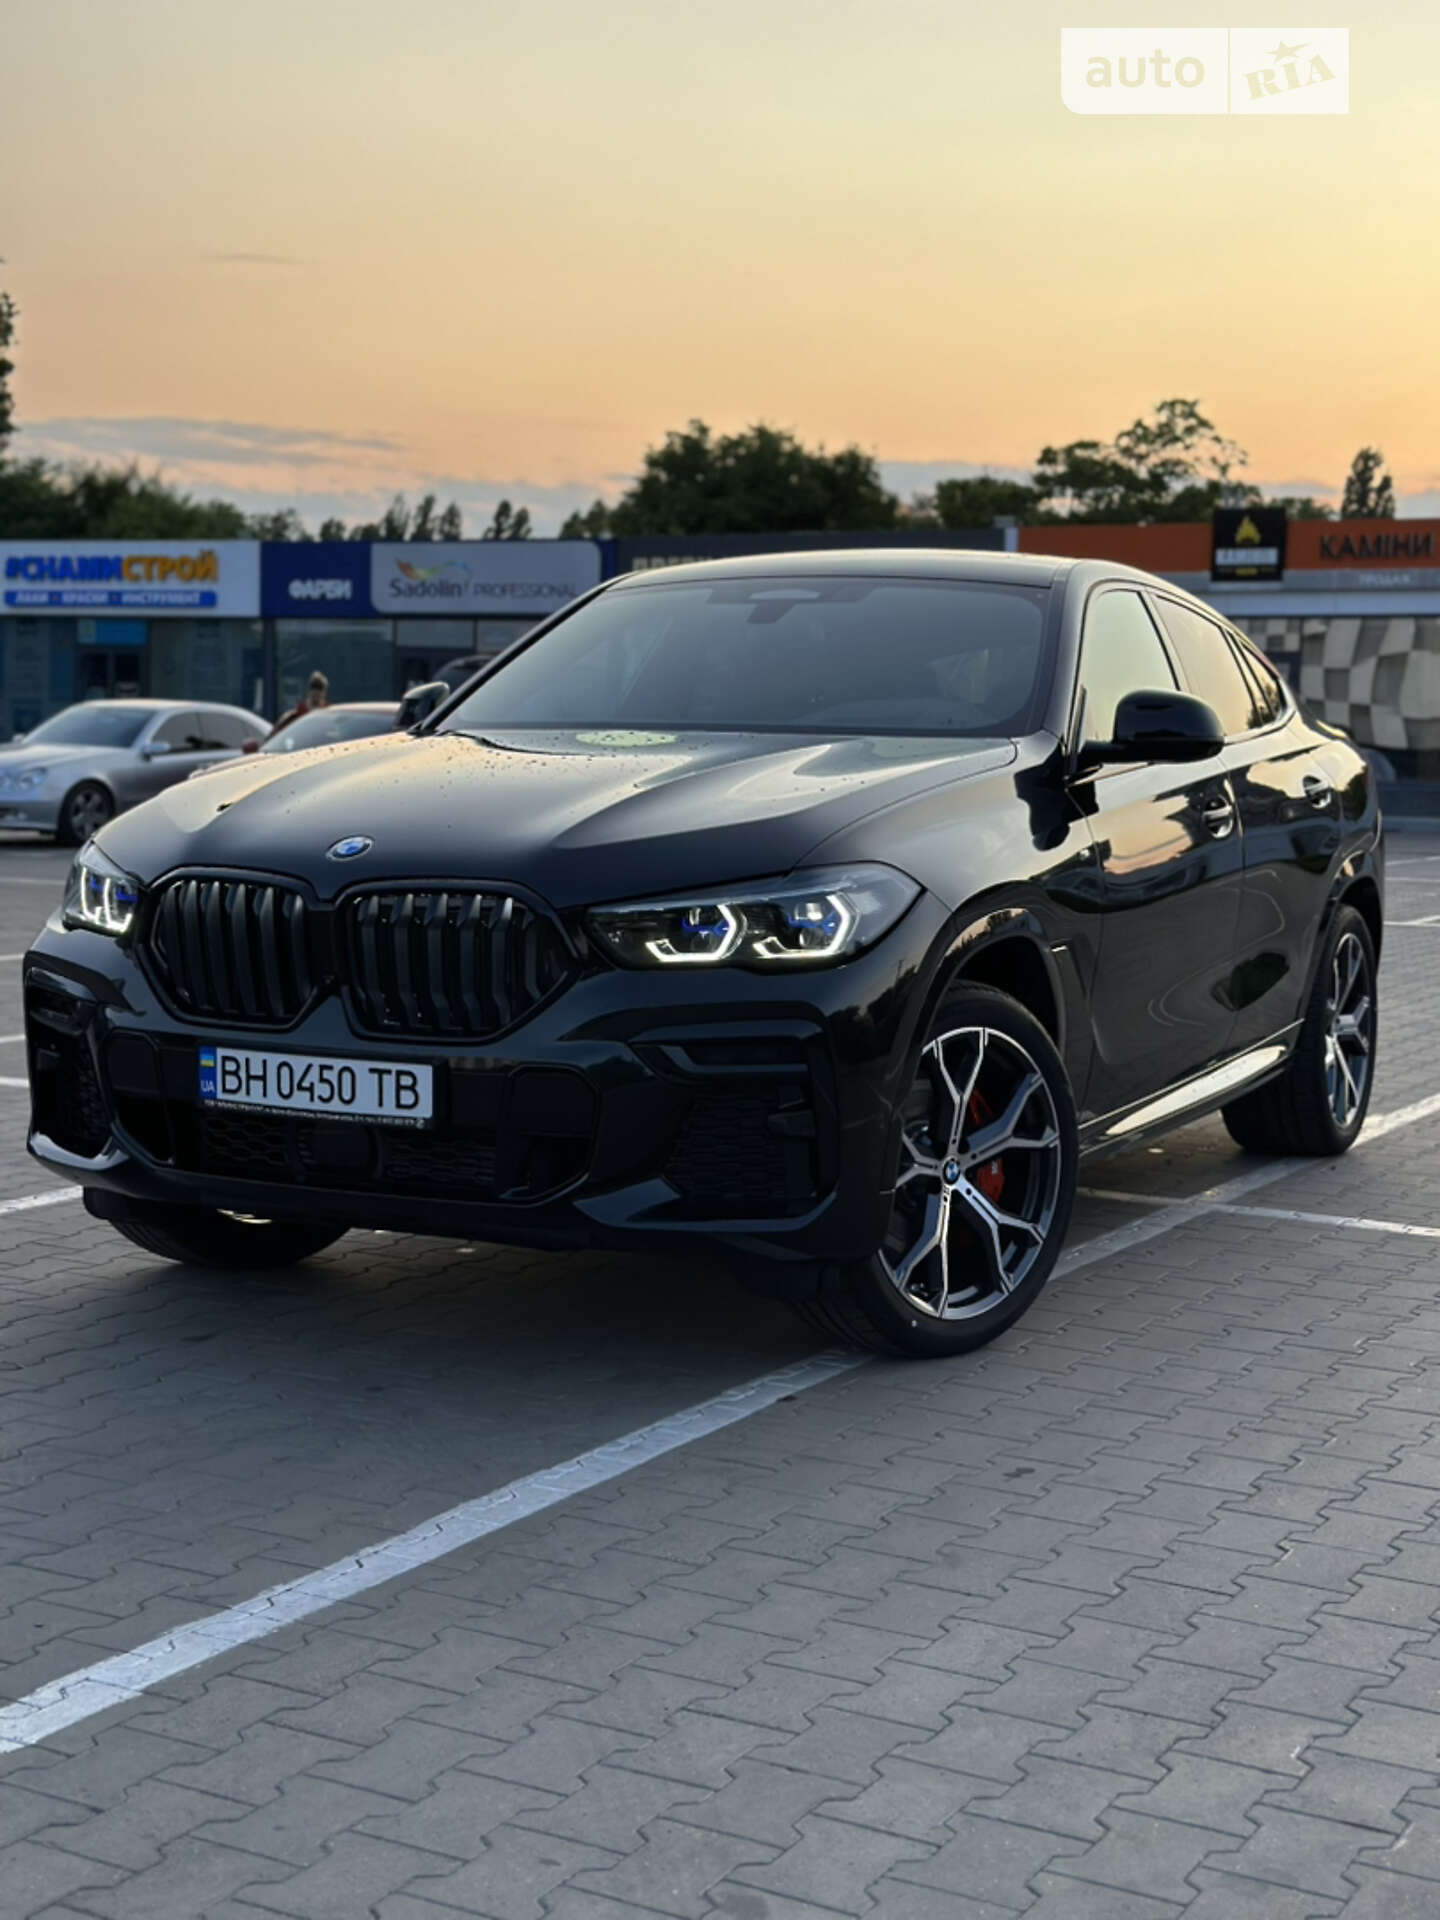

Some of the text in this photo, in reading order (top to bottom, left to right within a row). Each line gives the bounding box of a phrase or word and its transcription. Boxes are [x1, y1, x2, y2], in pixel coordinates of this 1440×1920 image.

[1320, 533, 1433, 559] КАМІНИ
[390, 578, 463, 598] Sadolin
[201, 1080, 215, 1093] UA
[221, 1055, 420, 1110] BH 0450 TB
